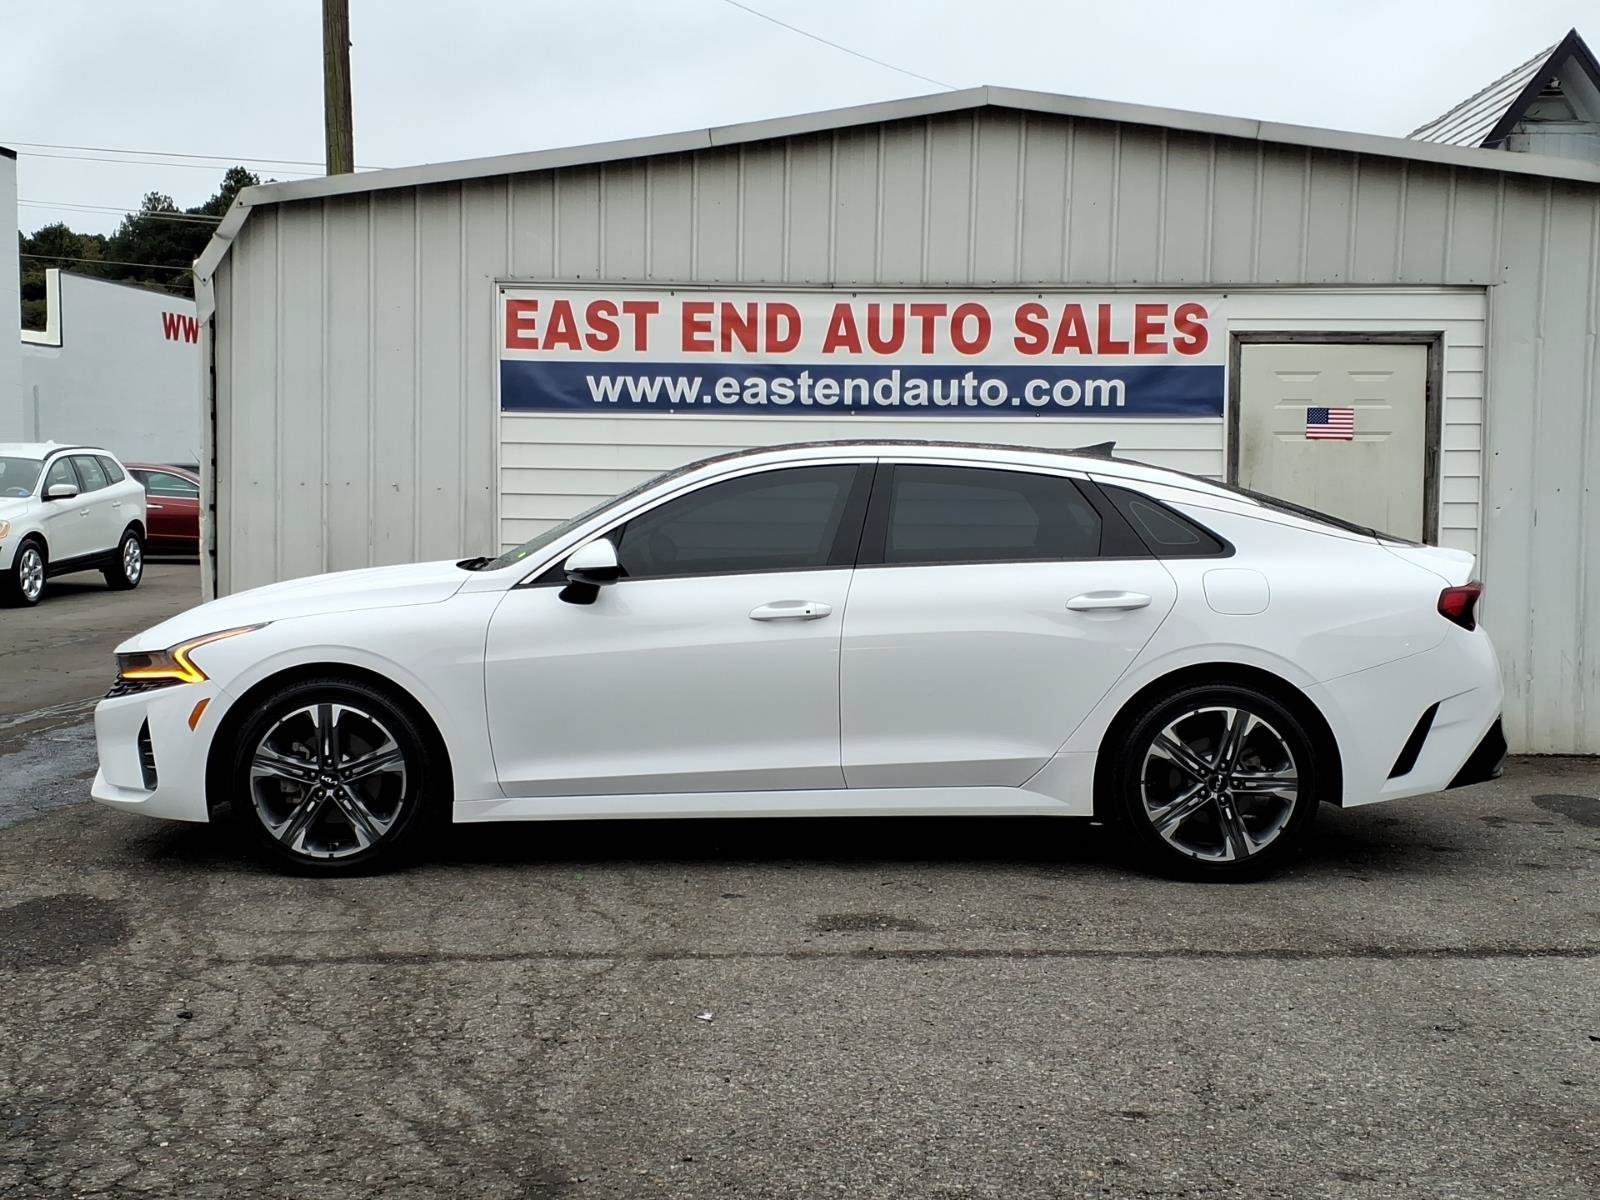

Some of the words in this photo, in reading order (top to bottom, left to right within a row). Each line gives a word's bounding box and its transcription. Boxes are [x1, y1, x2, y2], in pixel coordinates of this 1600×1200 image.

[504, 299, 660, 352] EAST
[681, 302, 802, 353] END
[822, 302, 992, 355] AUTO
[1013, 302, 1209, 356] SALES
[585, 369, 1126, 408] www.eastendauto.com
